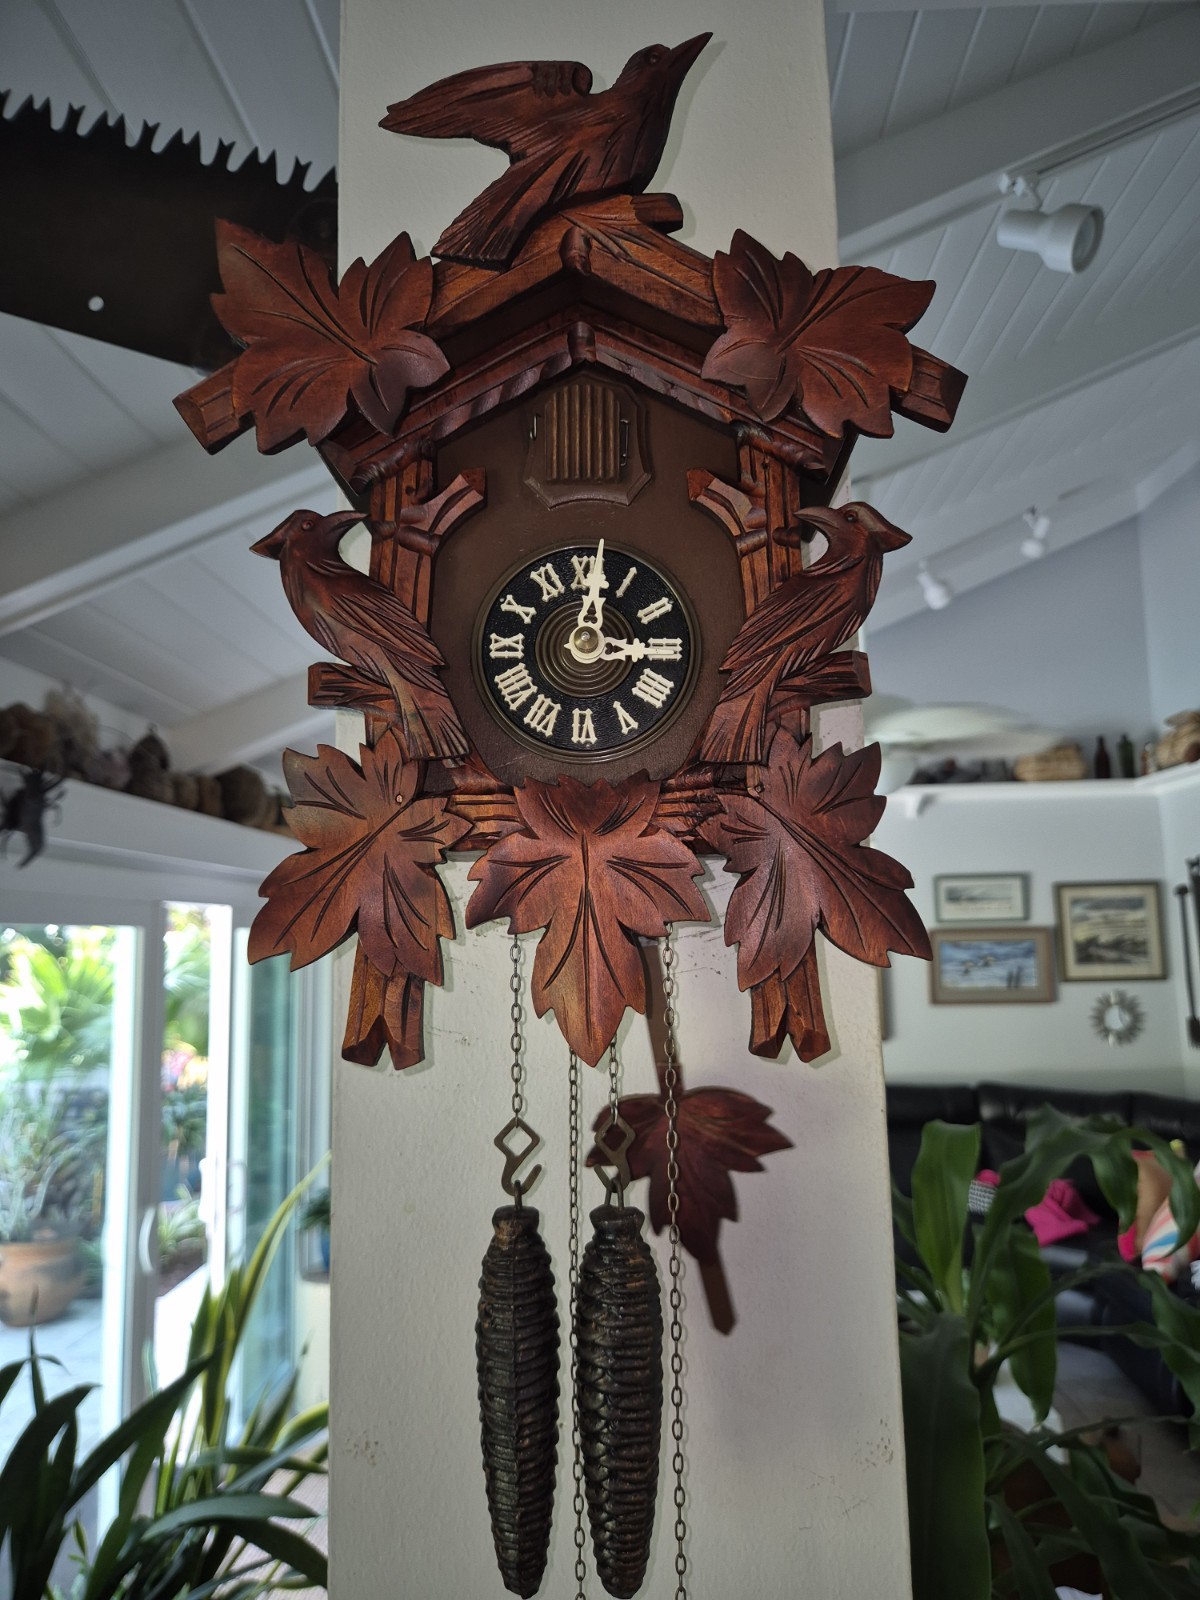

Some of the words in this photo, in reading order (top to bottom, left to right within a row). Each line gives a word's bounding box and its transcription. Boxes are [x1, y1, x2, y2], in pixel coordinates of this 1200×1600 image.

[530, 563, 565, 602] XI
[571, 555, 605, 590] XI
[616, 567, 637, 598] I
[501, 595, 537, 624] X
[637, 597, 673, 625] II
[489, 633, 525, 659] IX
[494, 663, 538, 711] VIII
[631, 668, 674, 709] IIII
[524, 694, 562, 737] VII
[571, 708, 598, 744] VI
[613, 701, 639, 735] V
